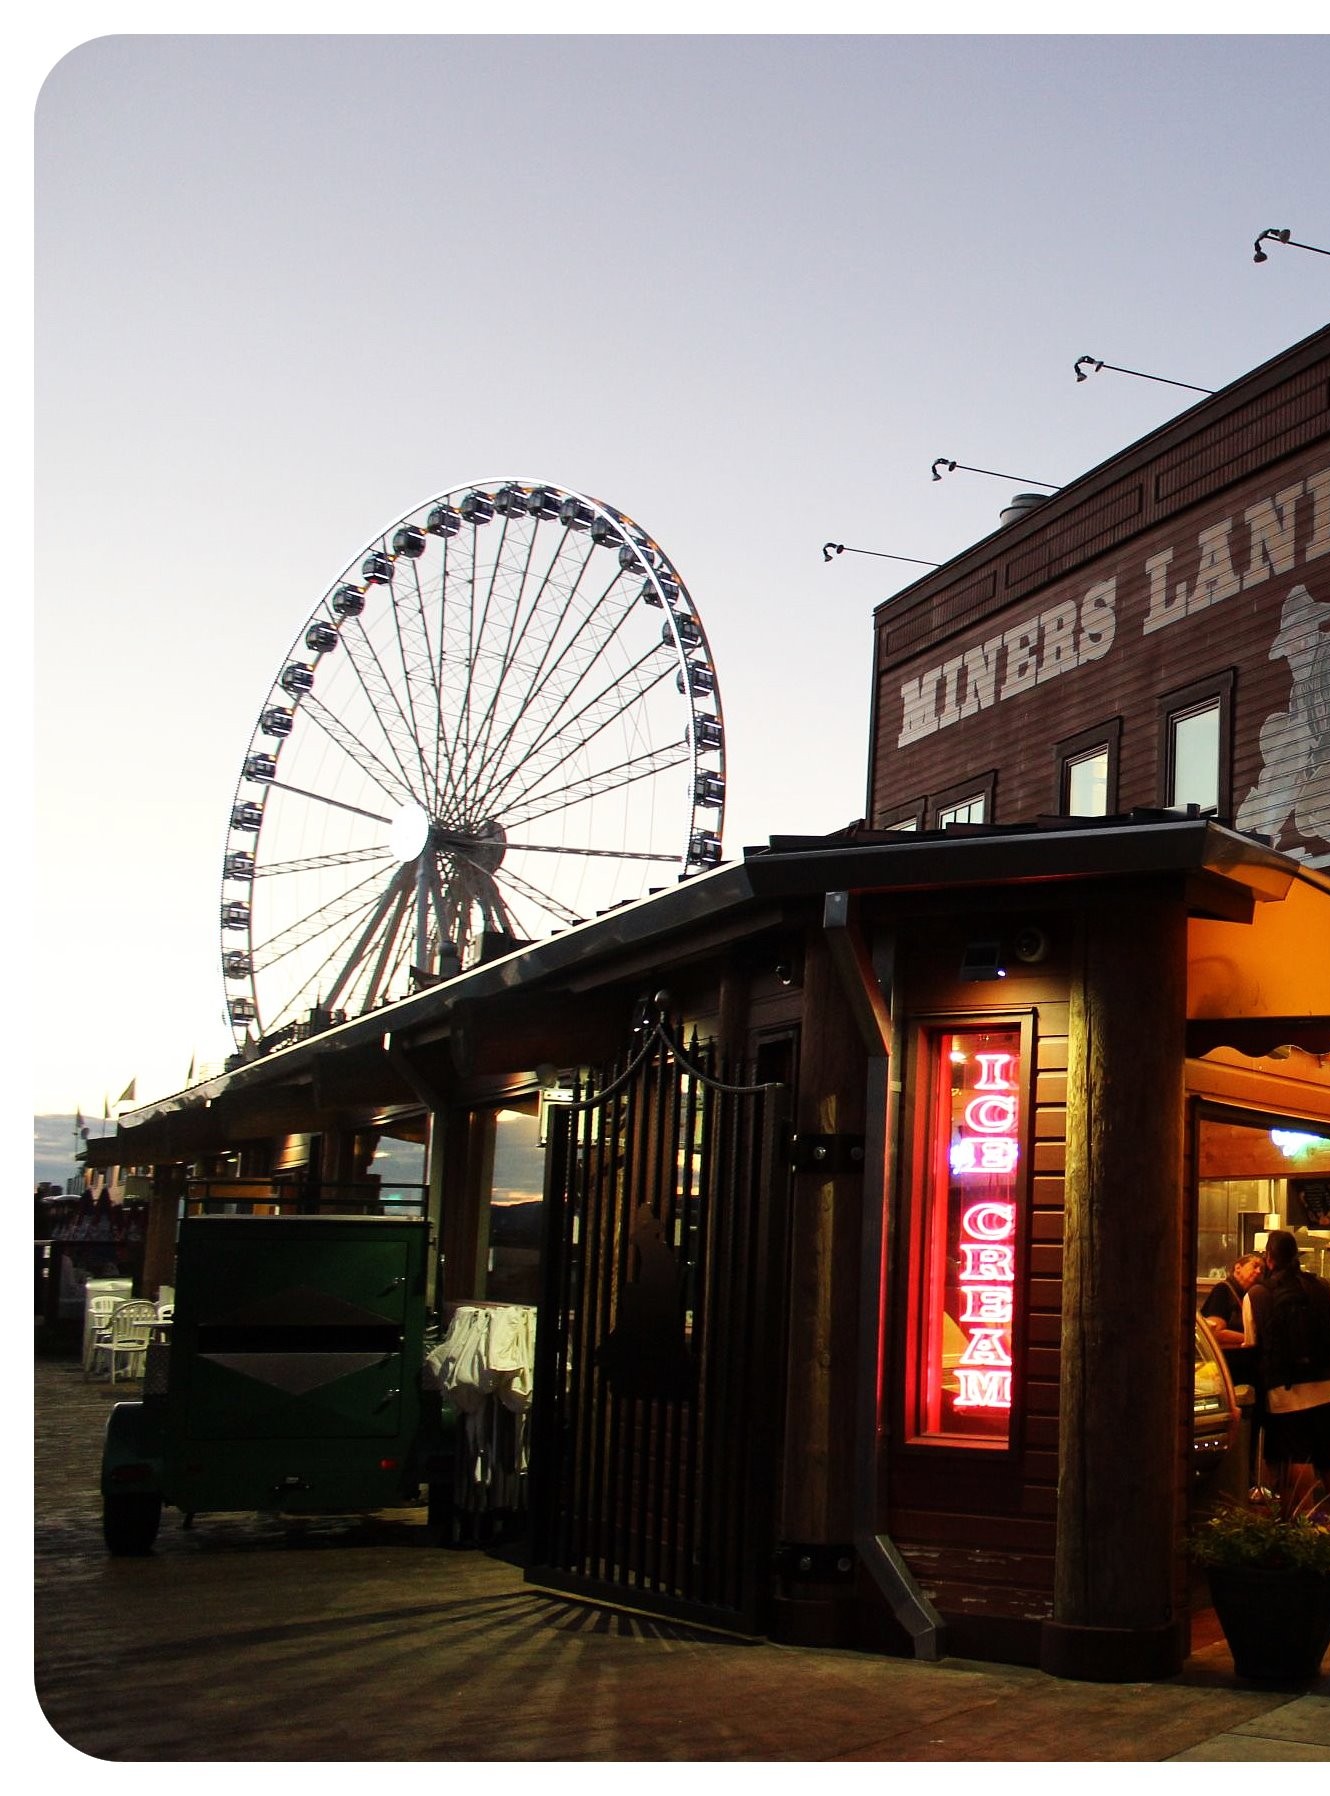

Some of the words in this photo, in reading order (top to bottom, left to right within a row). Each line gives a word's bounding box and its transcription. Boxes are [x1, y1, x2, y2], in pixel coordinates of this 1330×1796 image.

[898, 573, 1119, 749] MINERS
[963, 1053, 1018, 1174] ICE
[953, 1202, 1015, 1408] CREAM
